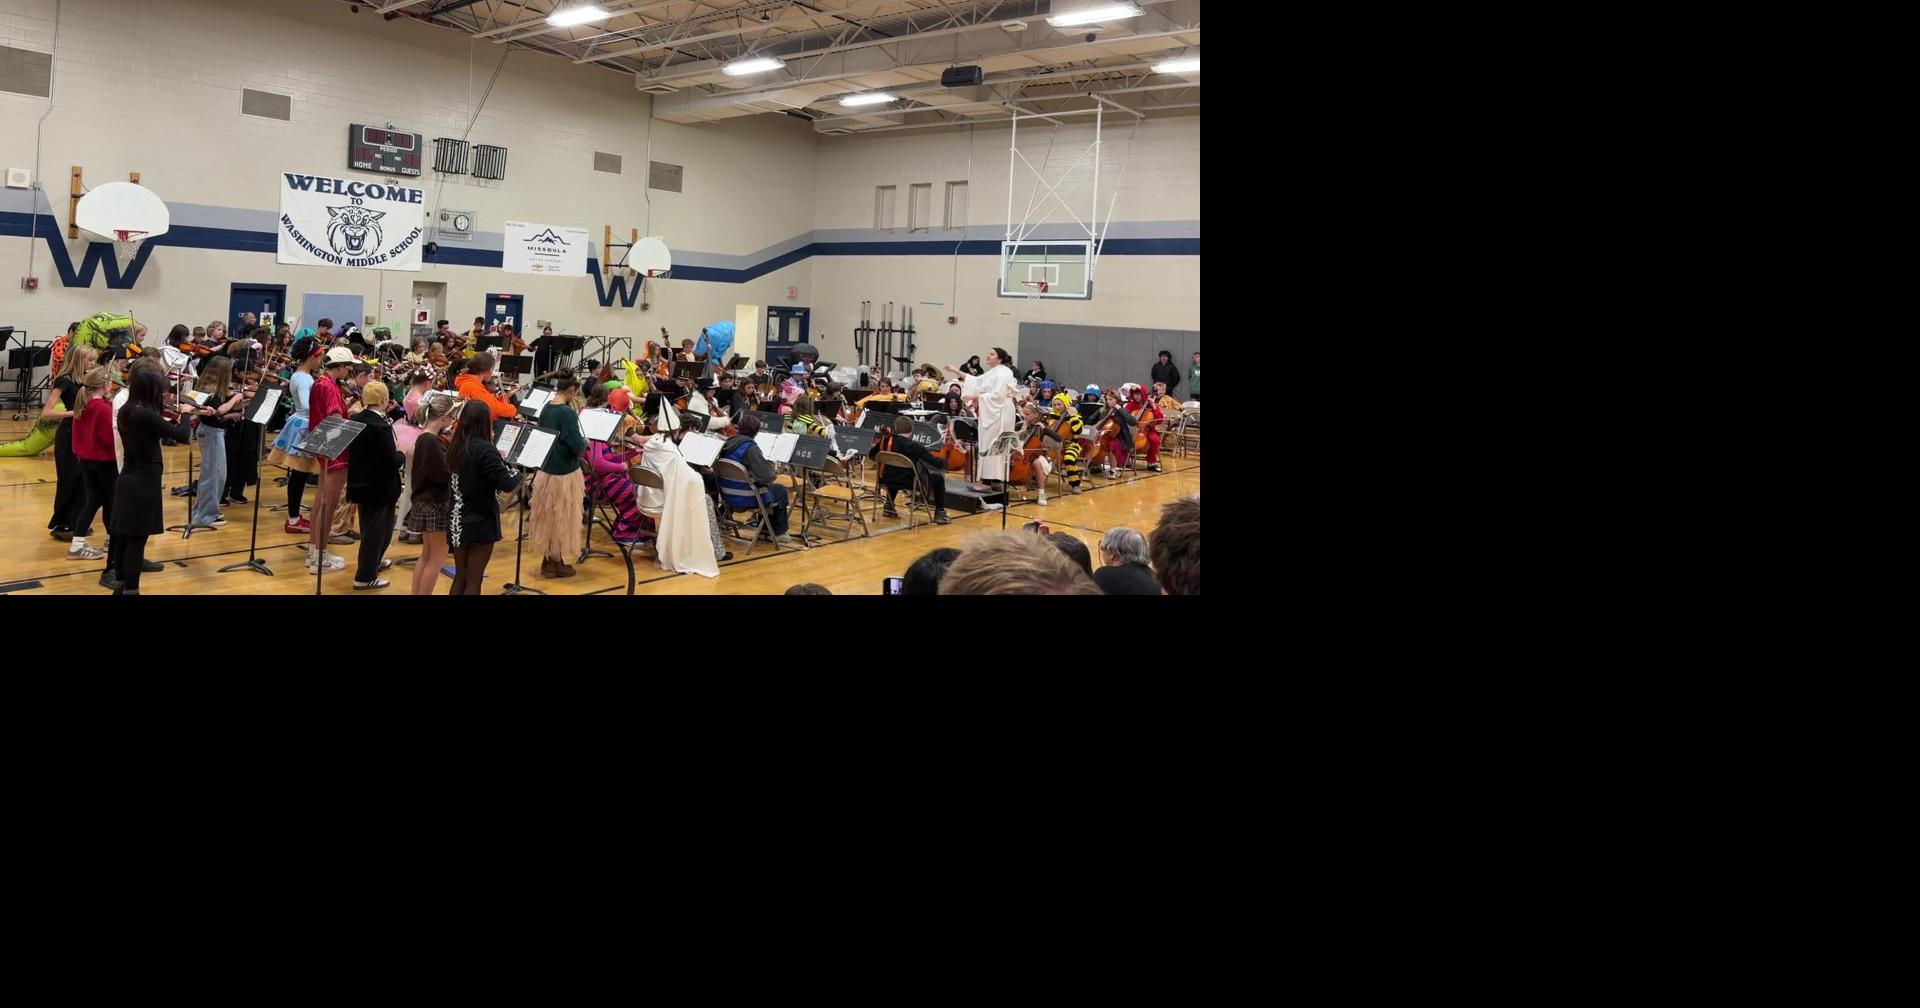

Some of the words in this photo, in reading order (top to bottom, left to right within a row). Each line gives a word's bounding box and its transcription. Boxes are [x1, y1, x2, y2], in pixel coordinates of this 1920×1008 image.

[354, 160, 372, 169] HOME
[401, 167, 421, 176] GUESTS
[284, 173, 423, 204] WELCOME
[350, 197, 363, 205] TO
[281, 213, 343, 265] WASHINGTON
[346, 253, 388, 267] MIDDLE
[389, 226, 422, 258] SCHOOL
